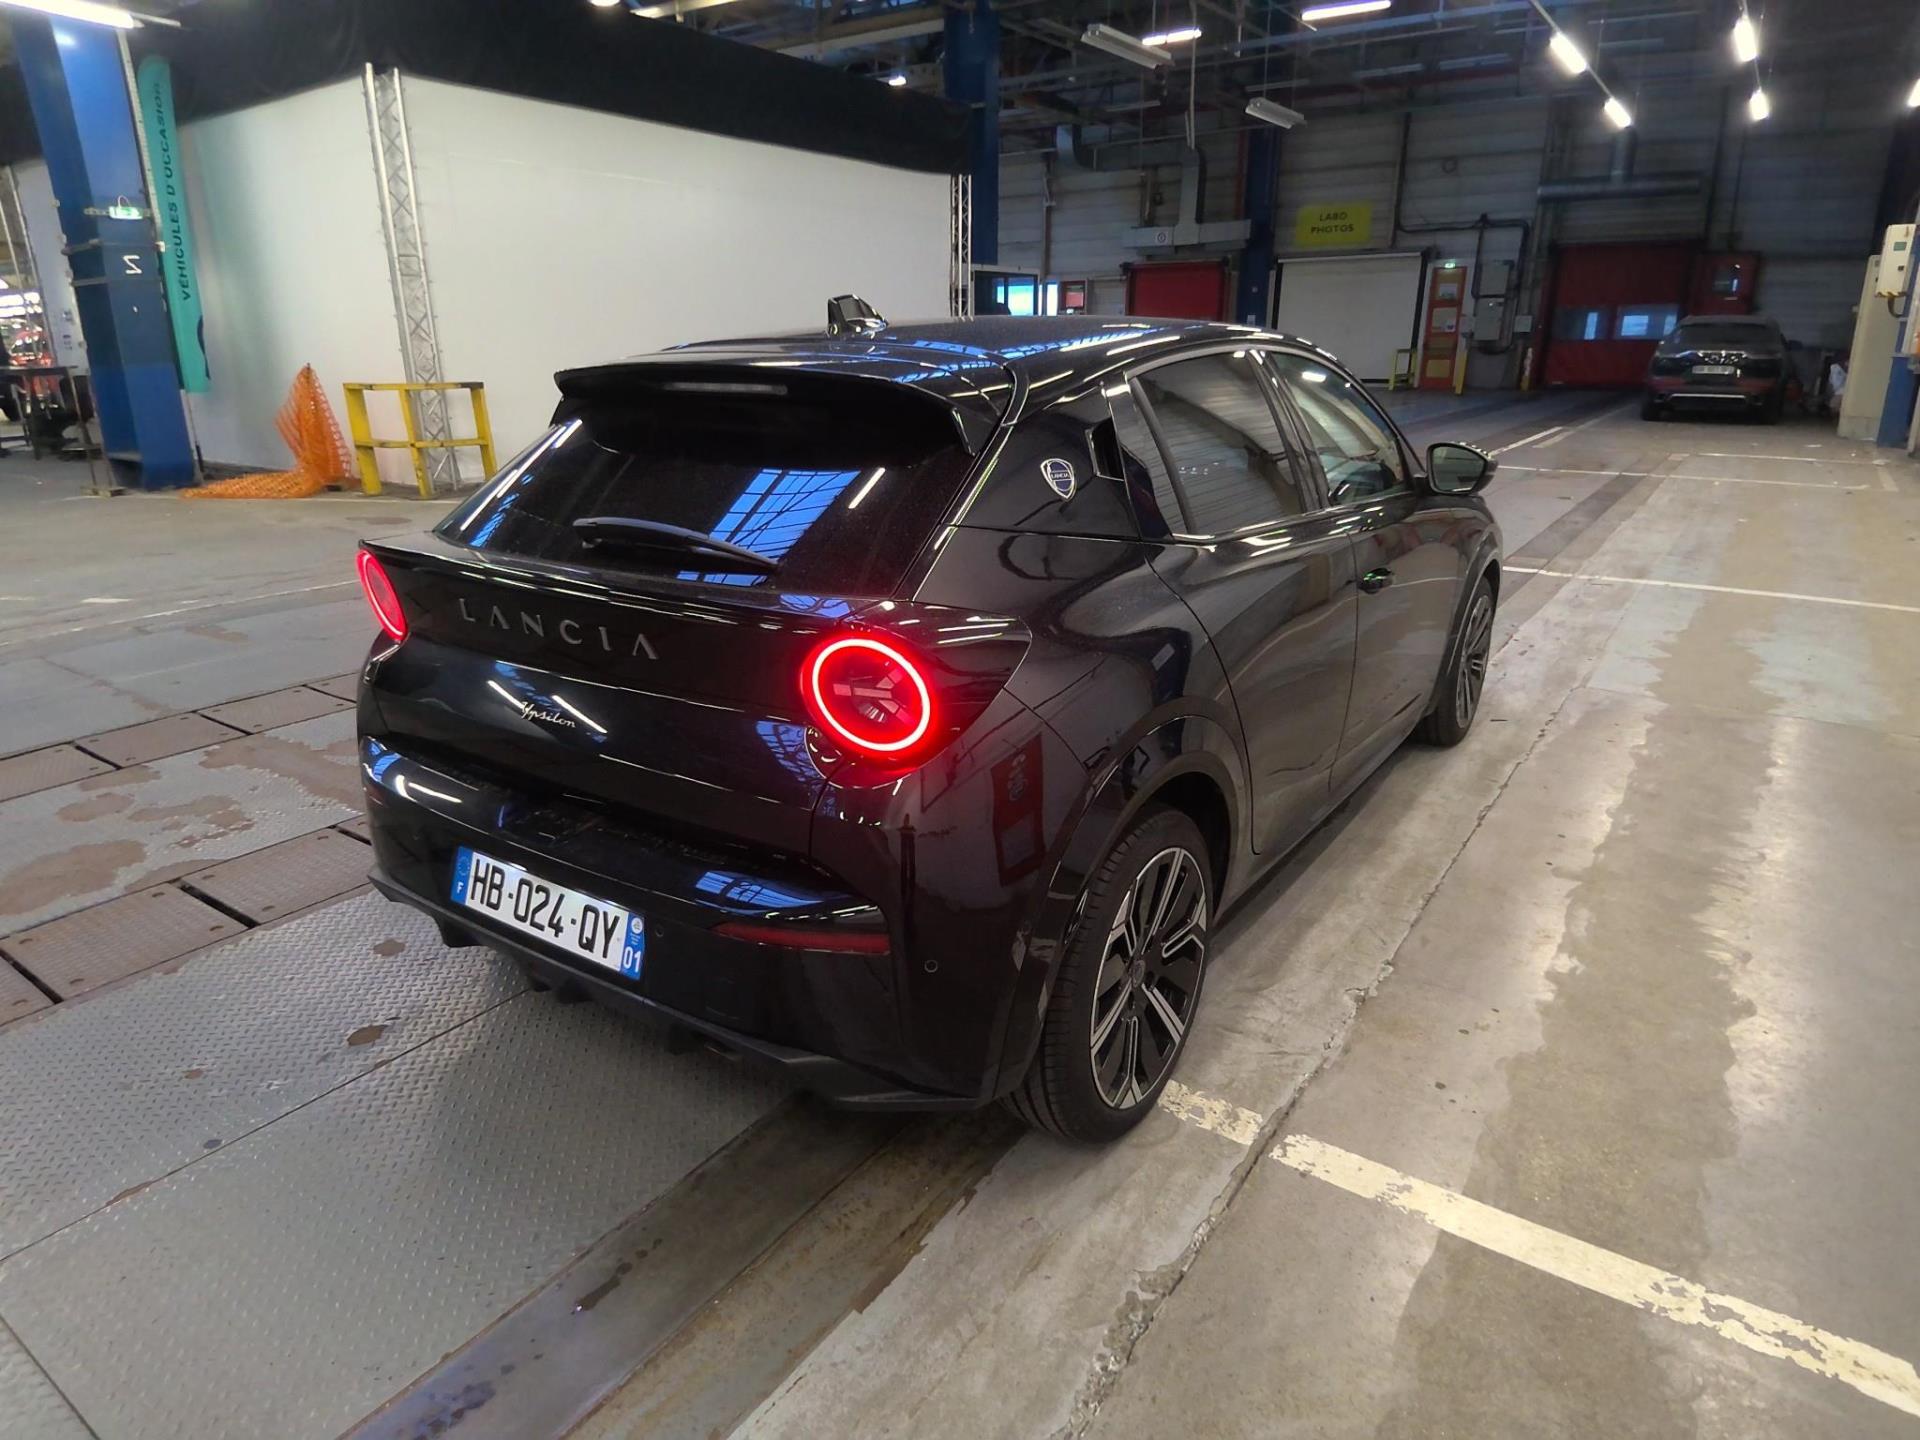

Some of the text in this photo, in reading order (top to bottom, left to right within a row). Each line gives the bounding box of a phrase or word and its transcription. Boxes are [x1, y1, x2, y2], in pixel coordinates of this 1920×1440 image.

[1319, 211, 1349, 222] LABO
[1310, 223, 1355, 234] PHOTOS
[459, 598, 660, 660] LANCIA
[520, 701, 577, 728] Ypsilon
[456, 881, 464, 894] F
[623, 945, 642, 973] 01
